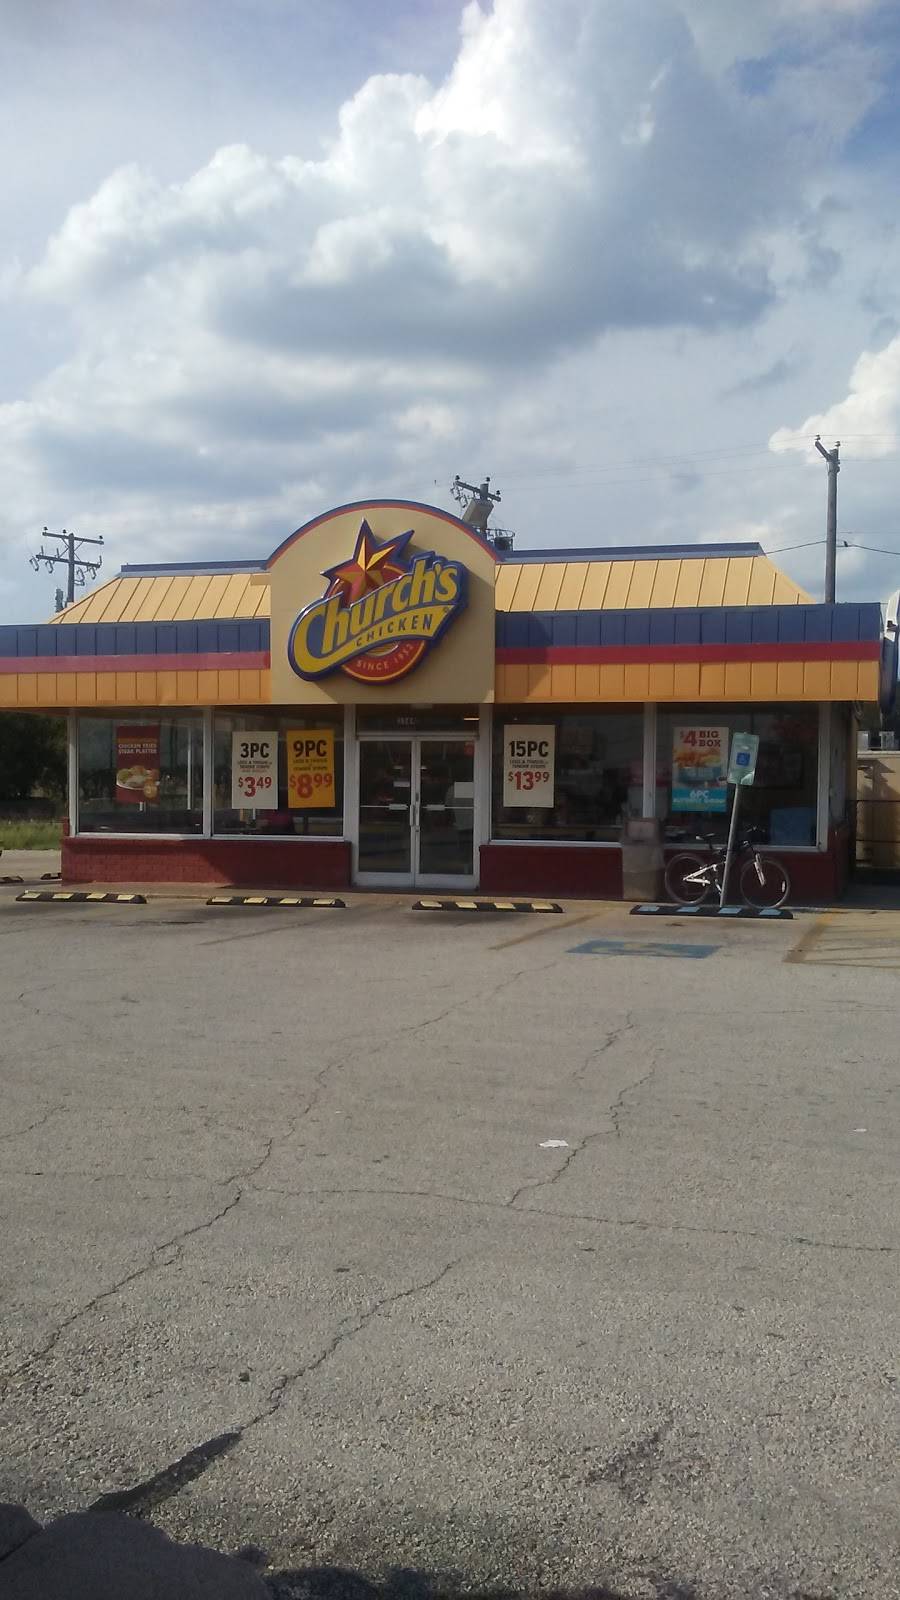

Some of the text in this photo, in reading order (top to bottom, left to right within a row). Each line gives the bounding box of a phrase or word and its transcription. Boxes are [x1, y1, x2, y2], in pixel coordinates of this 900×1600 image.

[293, 559, 458, 673] Church's
[355, 613, 433, 647] CHICKEN
[356, 659, 389, 671] SINCE
[699, 731, 719, 739] BIG
[240, 742, 270, 758] 3PC
[293, 740, 327, 758] 9PC
[508, 740, 549, 757] 15PC
[699, 740, 721, 748] BOX
